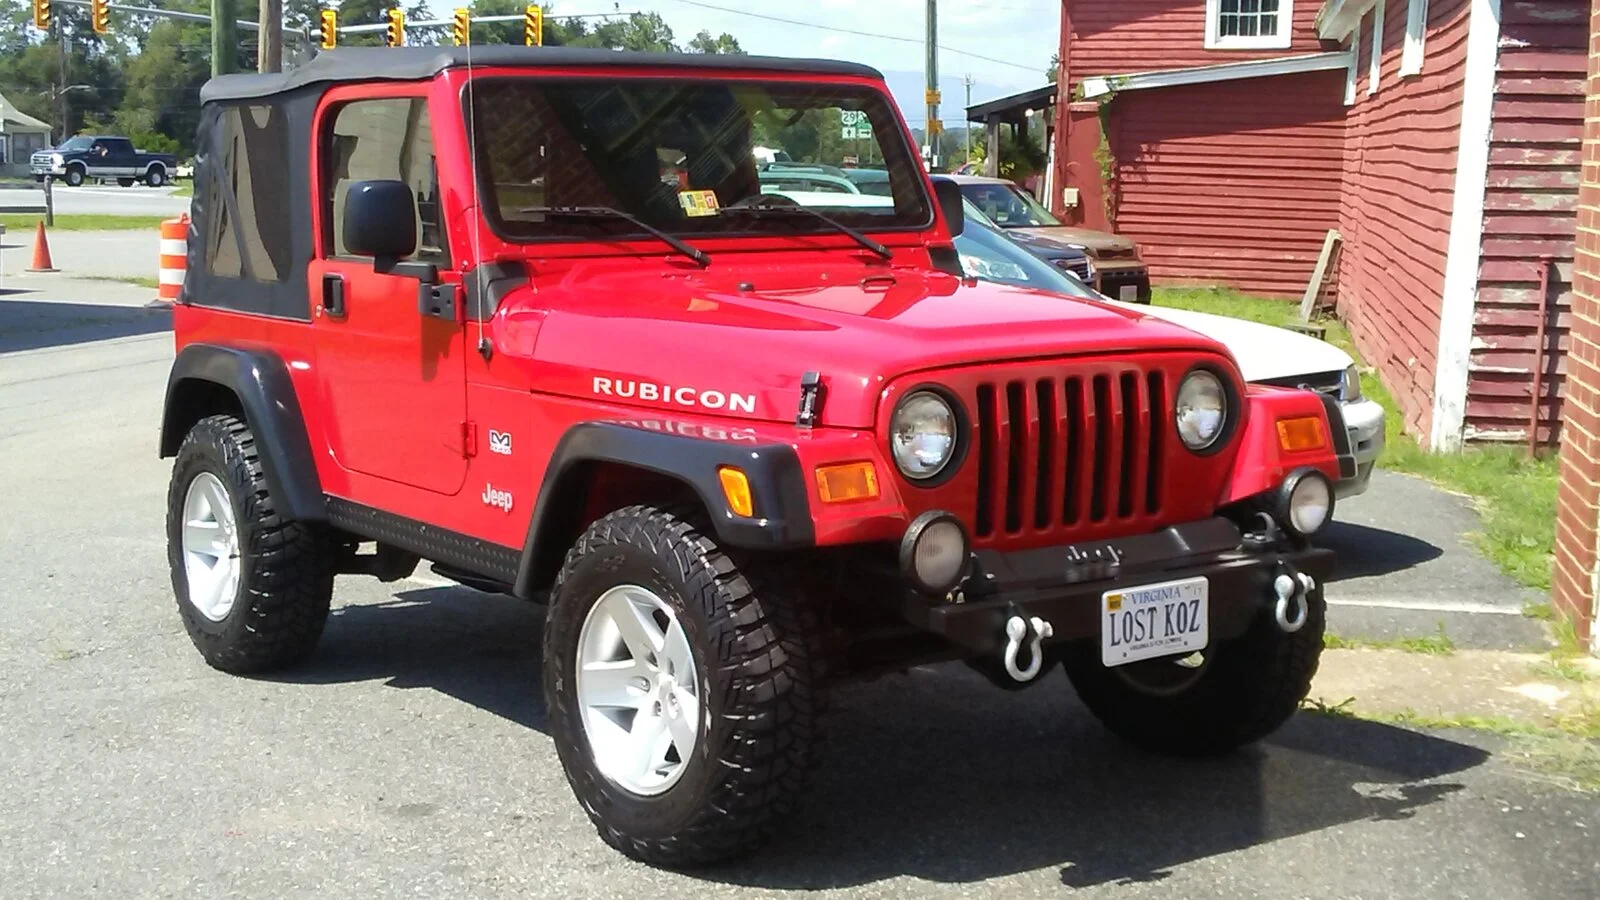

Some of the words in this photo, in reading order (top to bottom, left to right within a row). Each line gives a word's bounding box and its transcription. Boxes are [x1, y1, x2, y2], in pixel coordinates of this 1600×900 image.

[843, 112, 856, 122] 29
[593, 376, 756, 413] RUBICON
[482, 482, 513, 513] Jeep
[1131, 587, 1180, 605] VIRGINIA
[1109, 606, 1157, 647] LOST
[1164, 599, 1200, 637] KOZ
